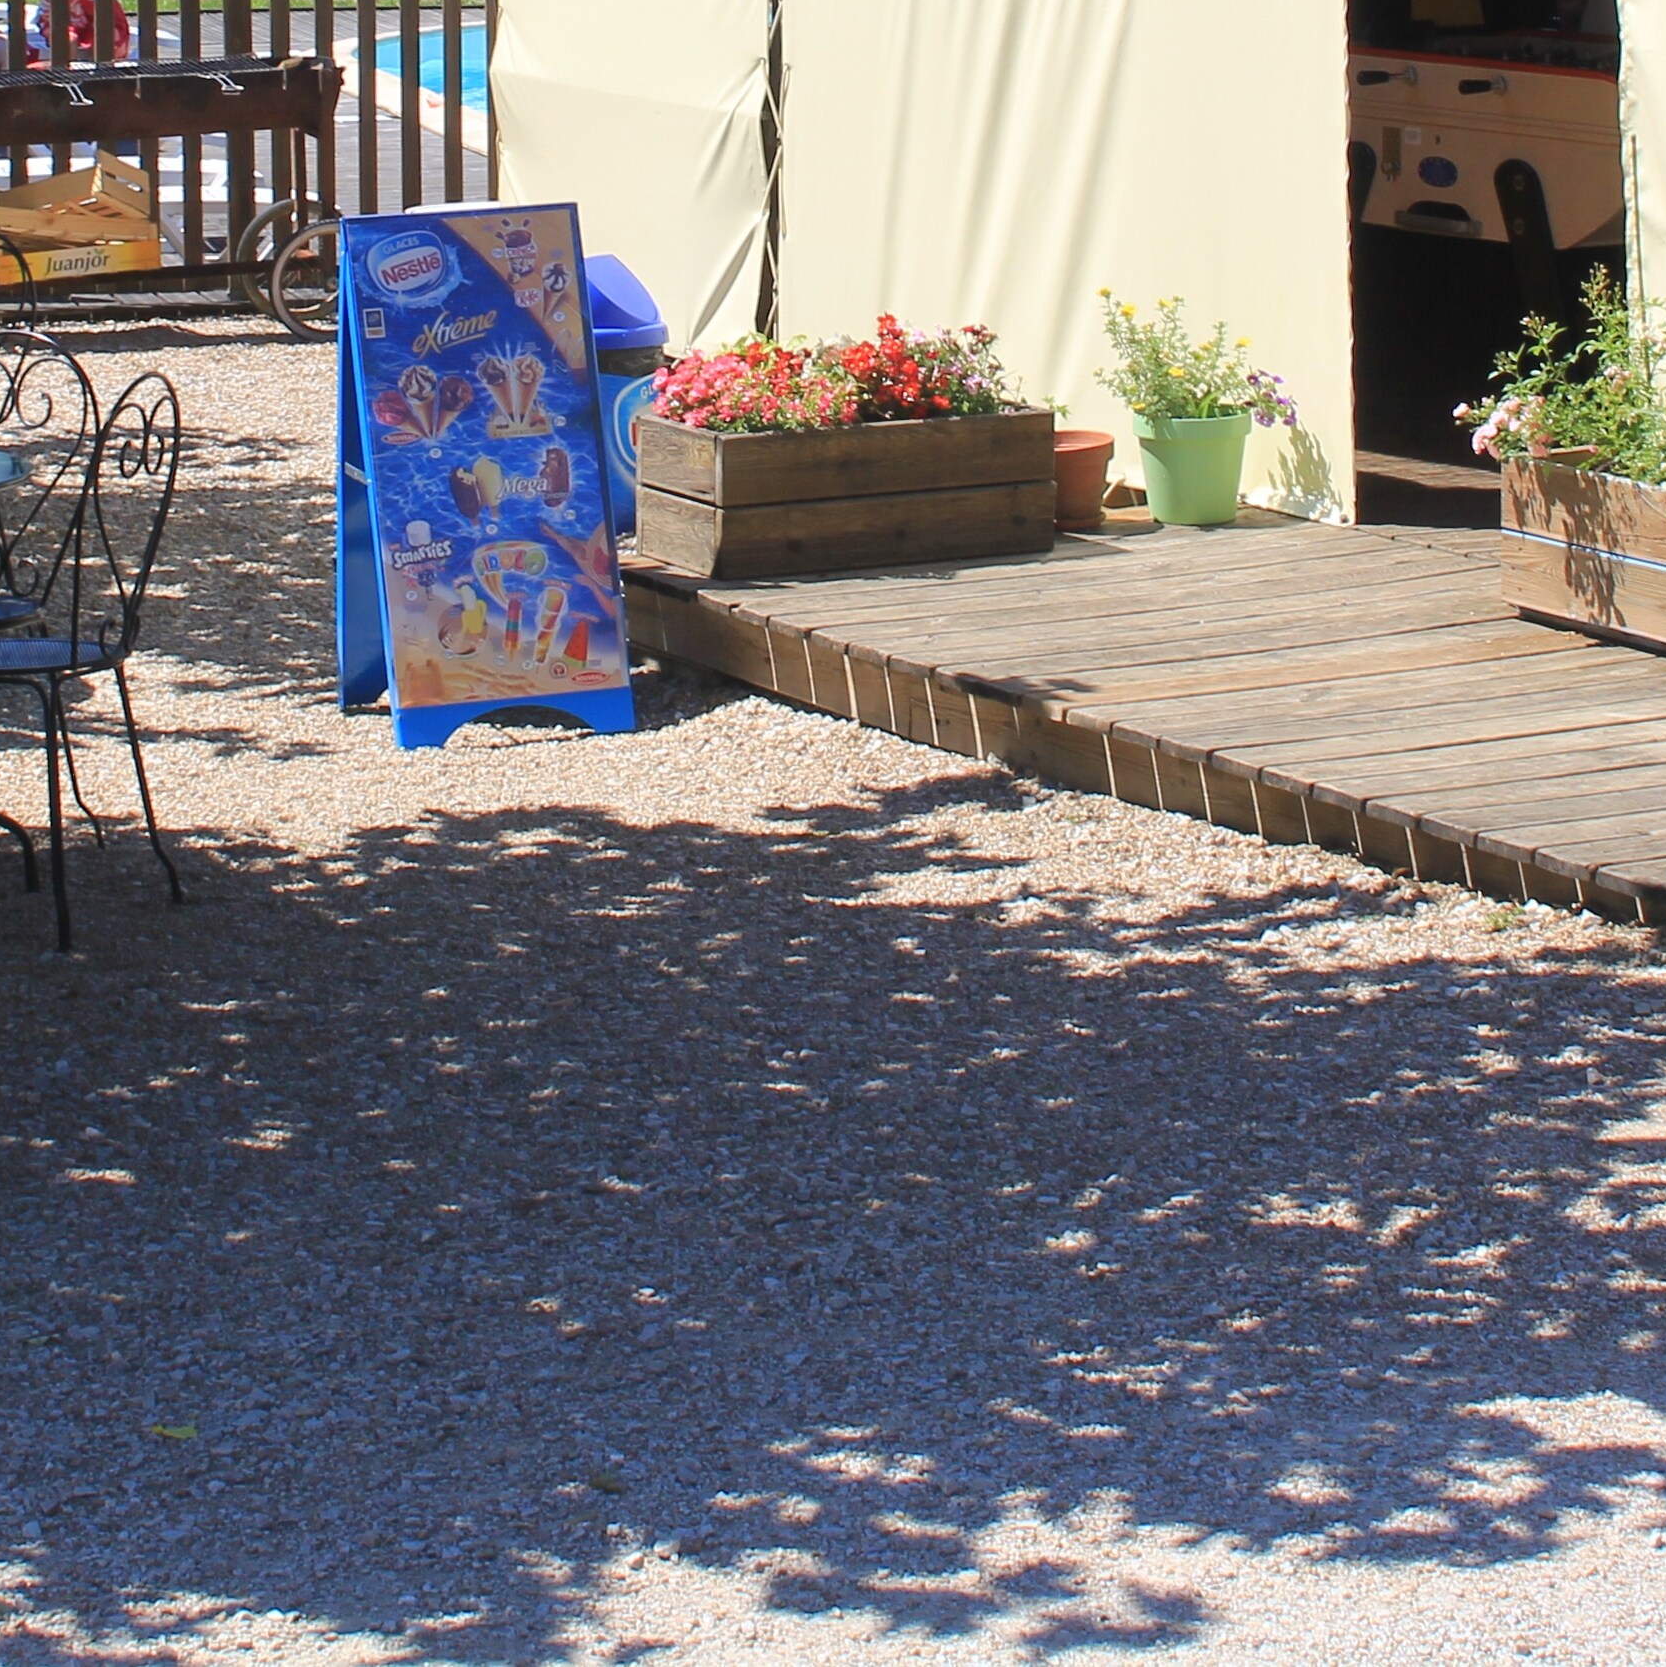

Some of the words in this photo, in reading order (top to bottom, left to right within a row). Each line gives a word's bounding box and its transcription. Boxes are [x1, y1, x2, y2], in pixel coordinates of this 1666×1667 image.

[383, 236, 420, 255] GLACES
[381, 251, 441, 286] Nestlé
[496, 476, 548, 499] Mega
